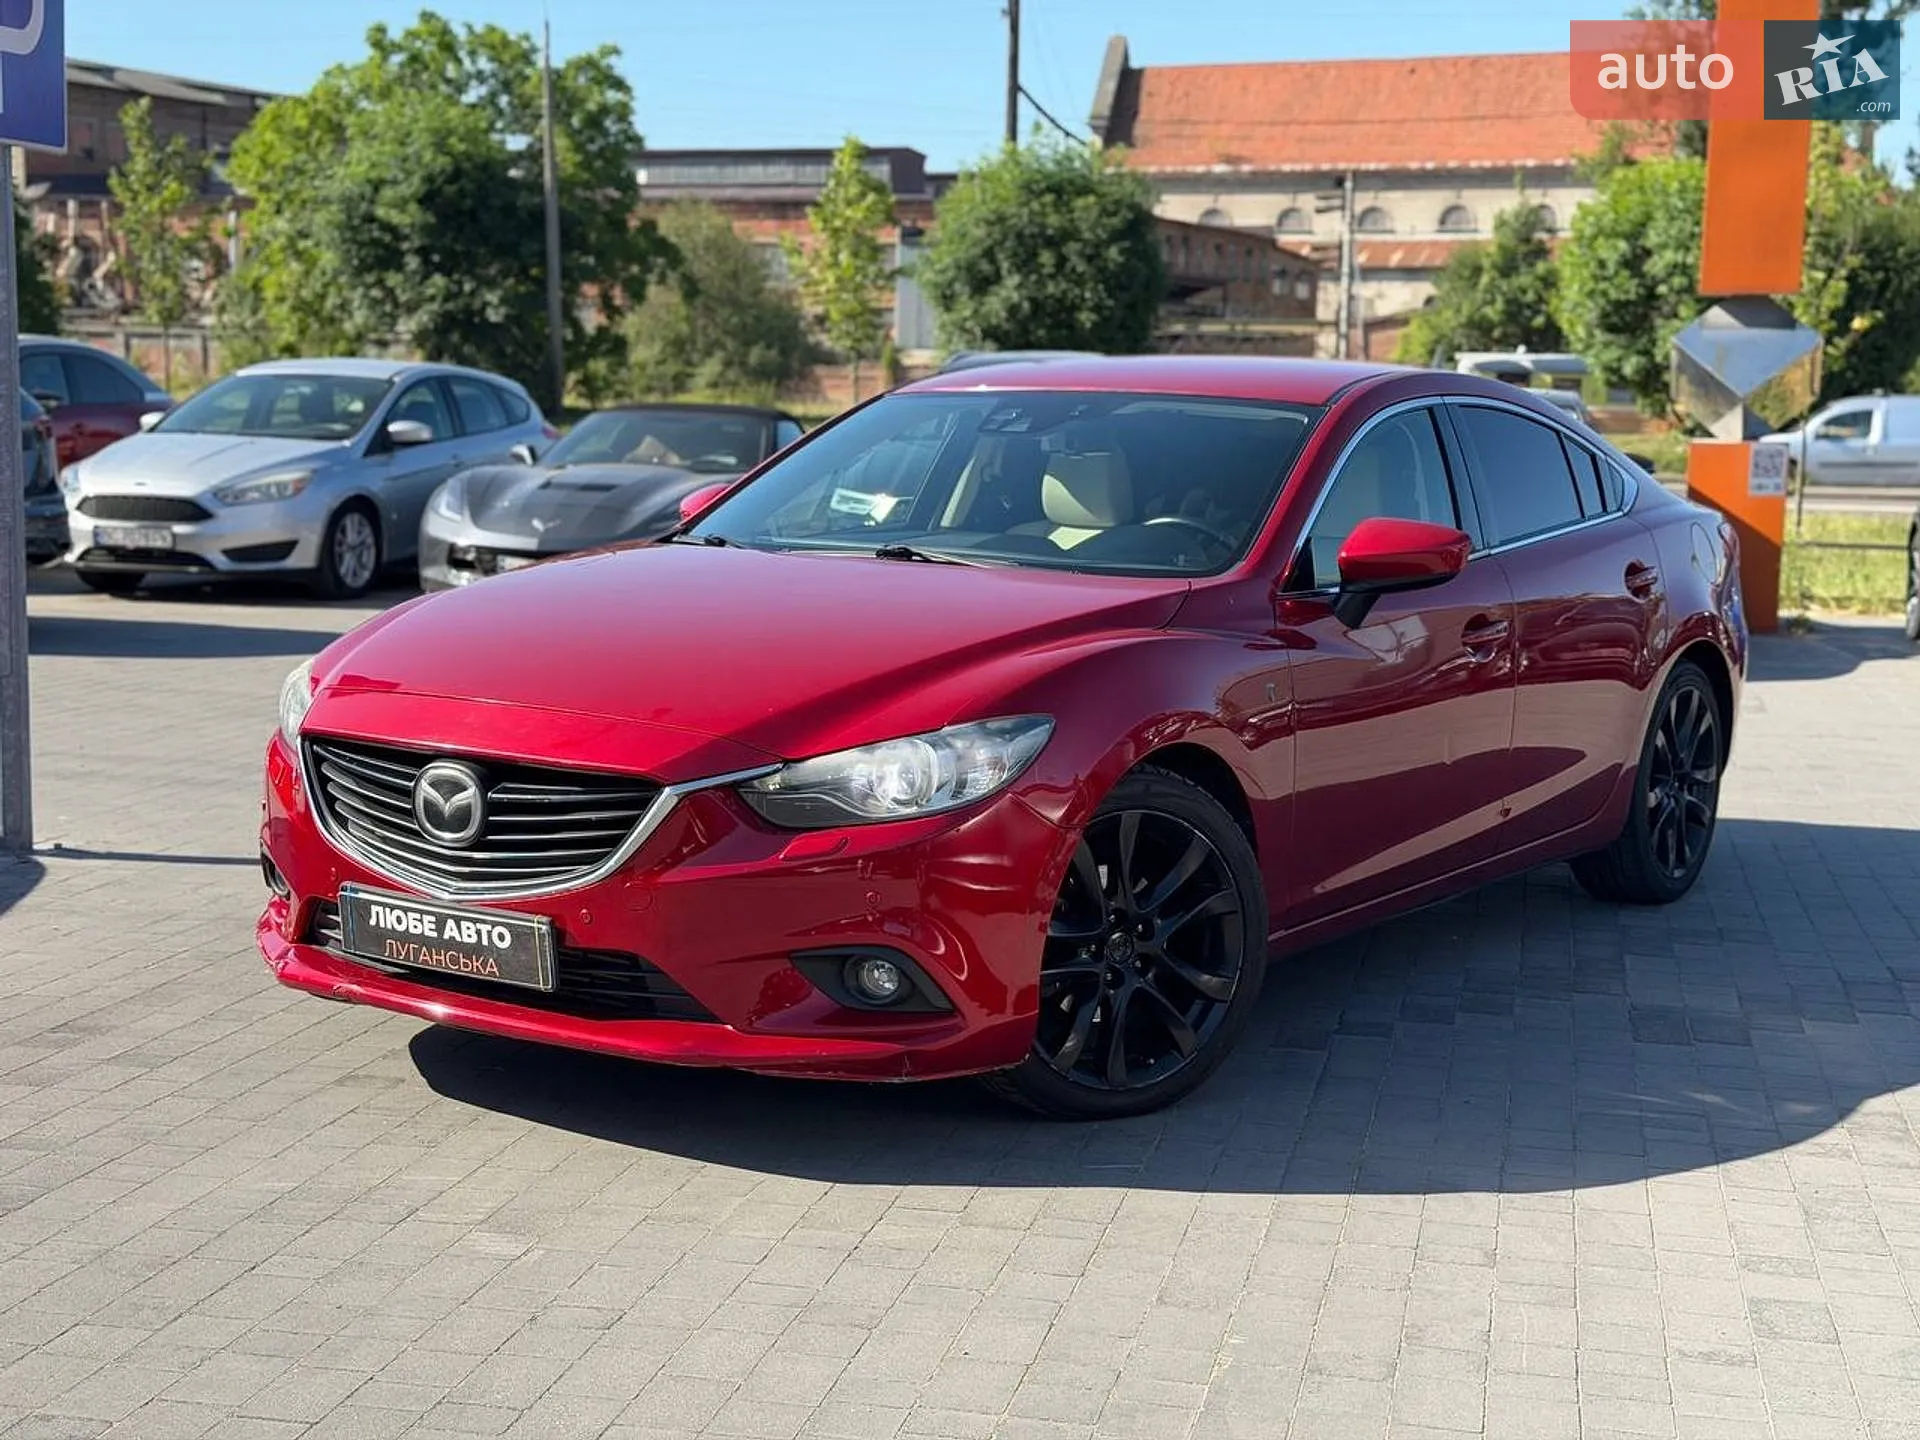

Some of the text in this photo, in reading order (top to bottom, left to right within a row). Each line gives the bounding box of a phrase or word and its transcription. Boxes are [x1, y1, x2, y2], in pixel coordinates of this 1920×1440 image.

[369, 904, 512, 949] ЛЮБЕ АВТО
[384, 939, 499, 976] ЛУГАНСЬКА
